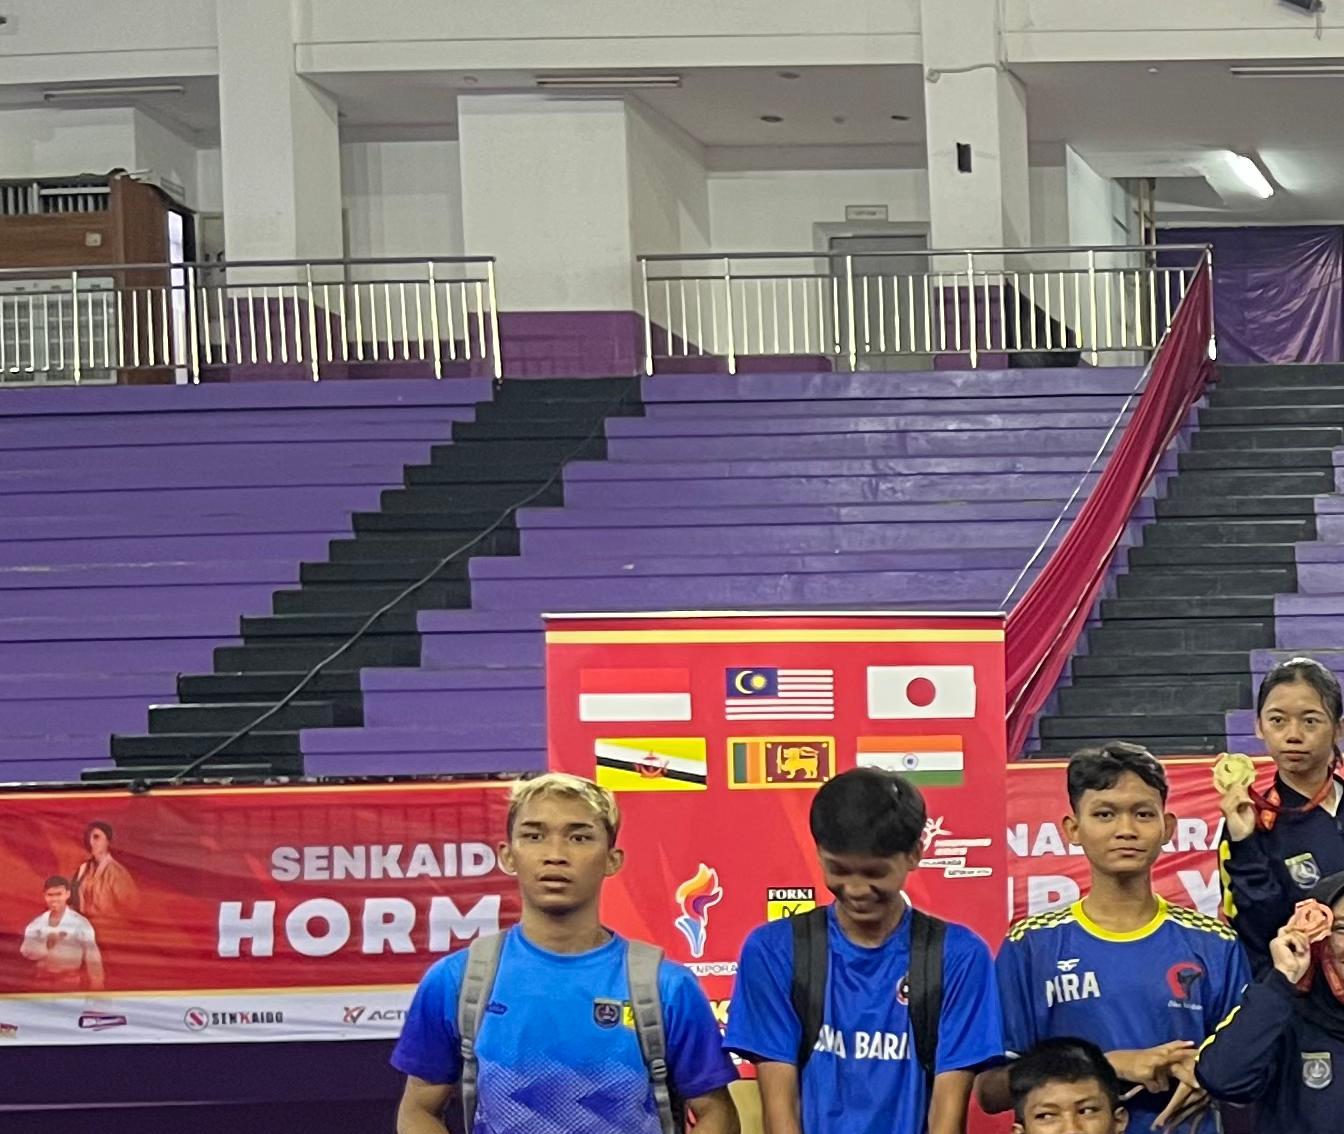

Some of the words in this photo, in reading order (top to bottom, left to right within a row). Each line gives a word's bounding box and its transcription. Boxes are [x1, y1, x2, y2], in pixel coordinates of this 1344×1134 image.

[768, 888, 815, 901] FORKI
[218, 894, 502, 957] HORM
[211, 1007, 284, 1026] SENKAIDO
